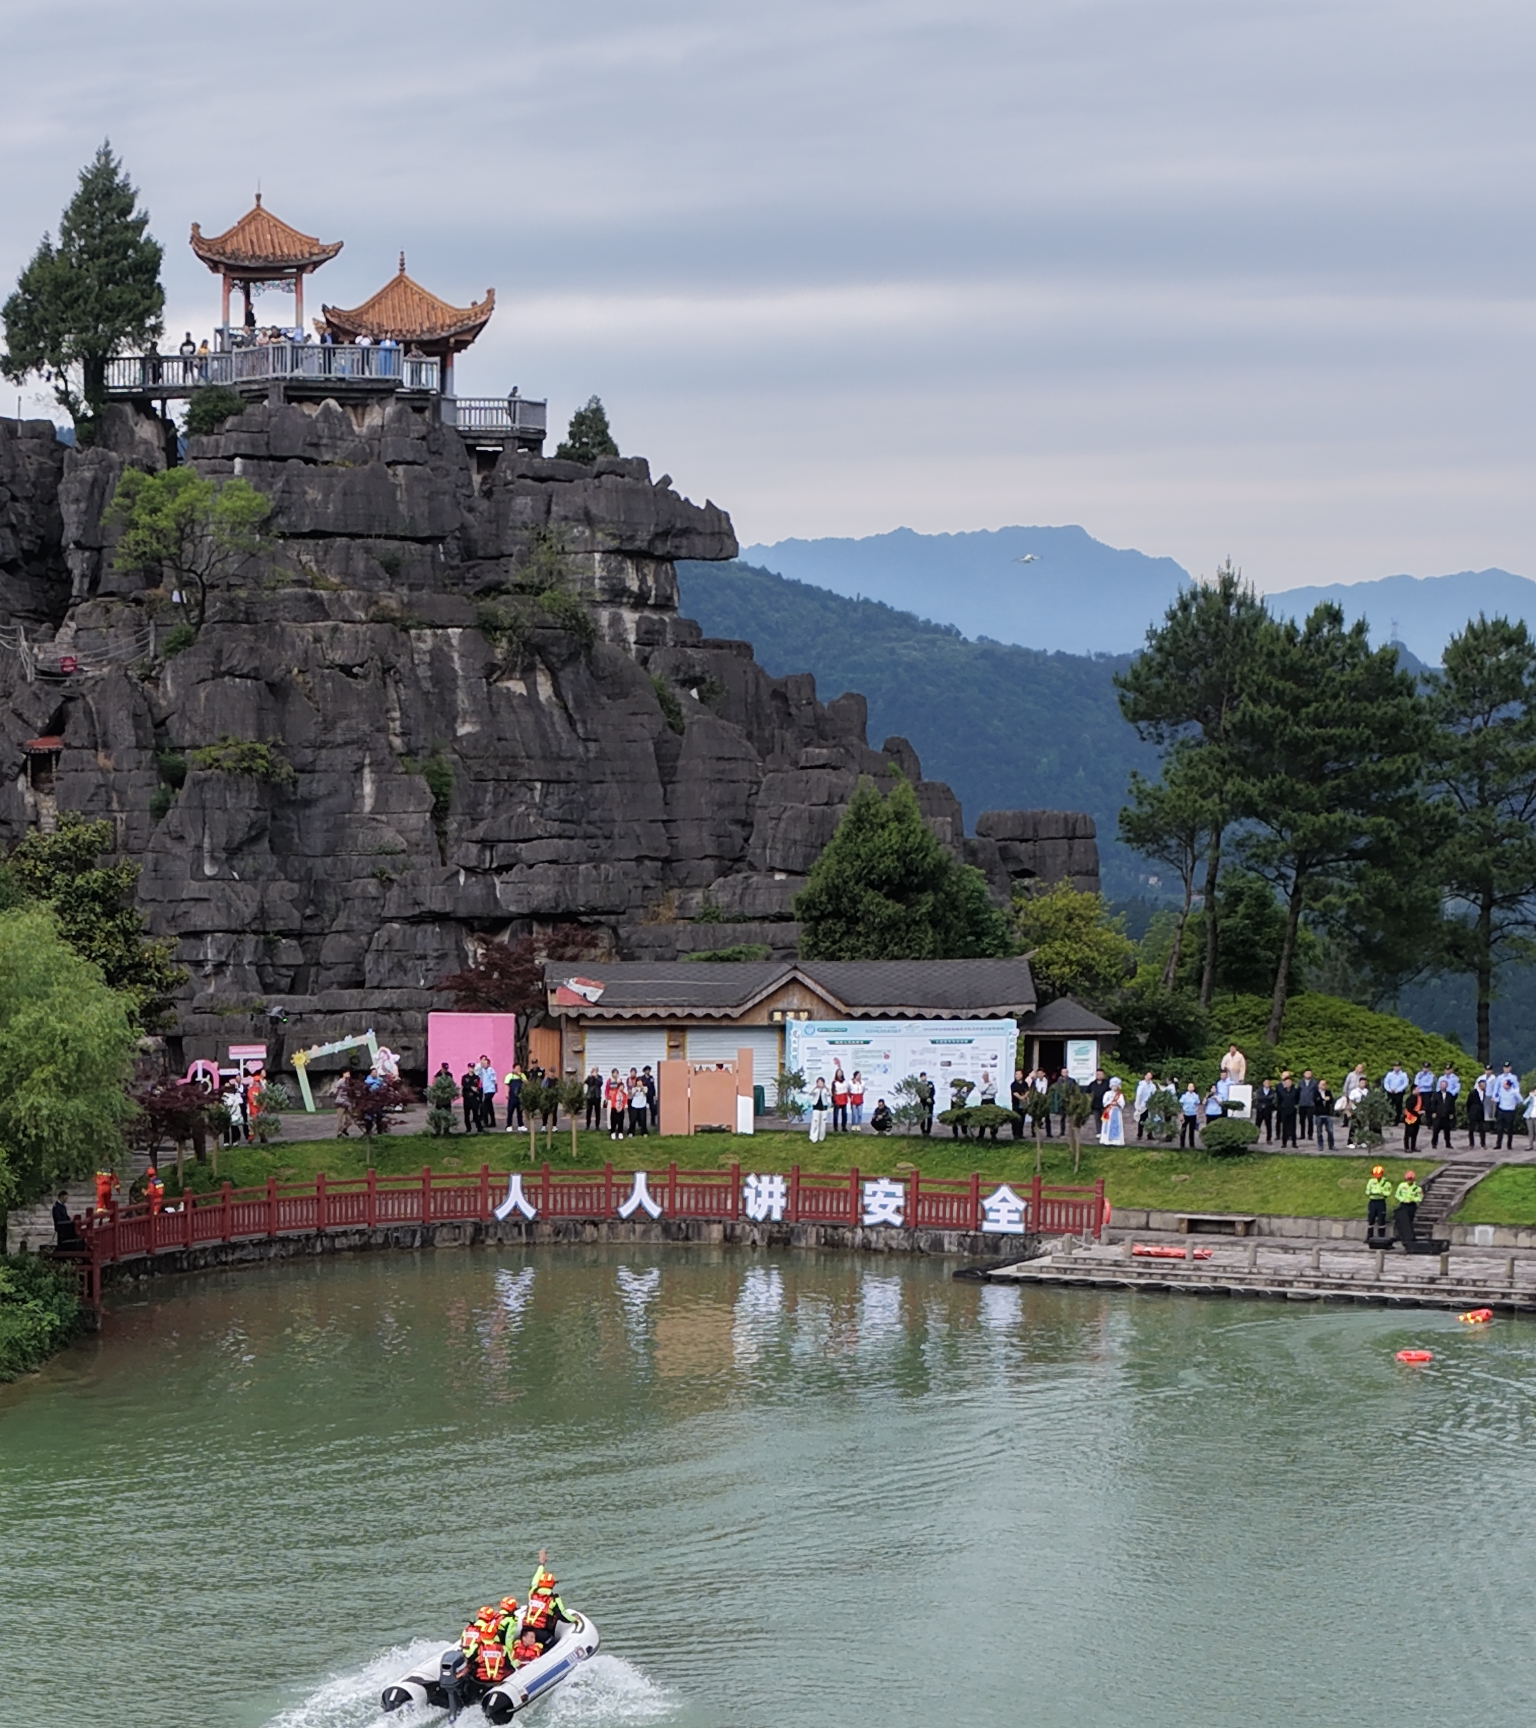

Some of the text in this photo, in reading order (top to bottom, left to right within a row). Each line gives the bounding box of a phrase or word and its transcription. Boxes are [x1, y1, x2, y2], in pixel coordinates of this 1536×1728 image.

[494, 1172, 1028, 1234] 人人讲安全
